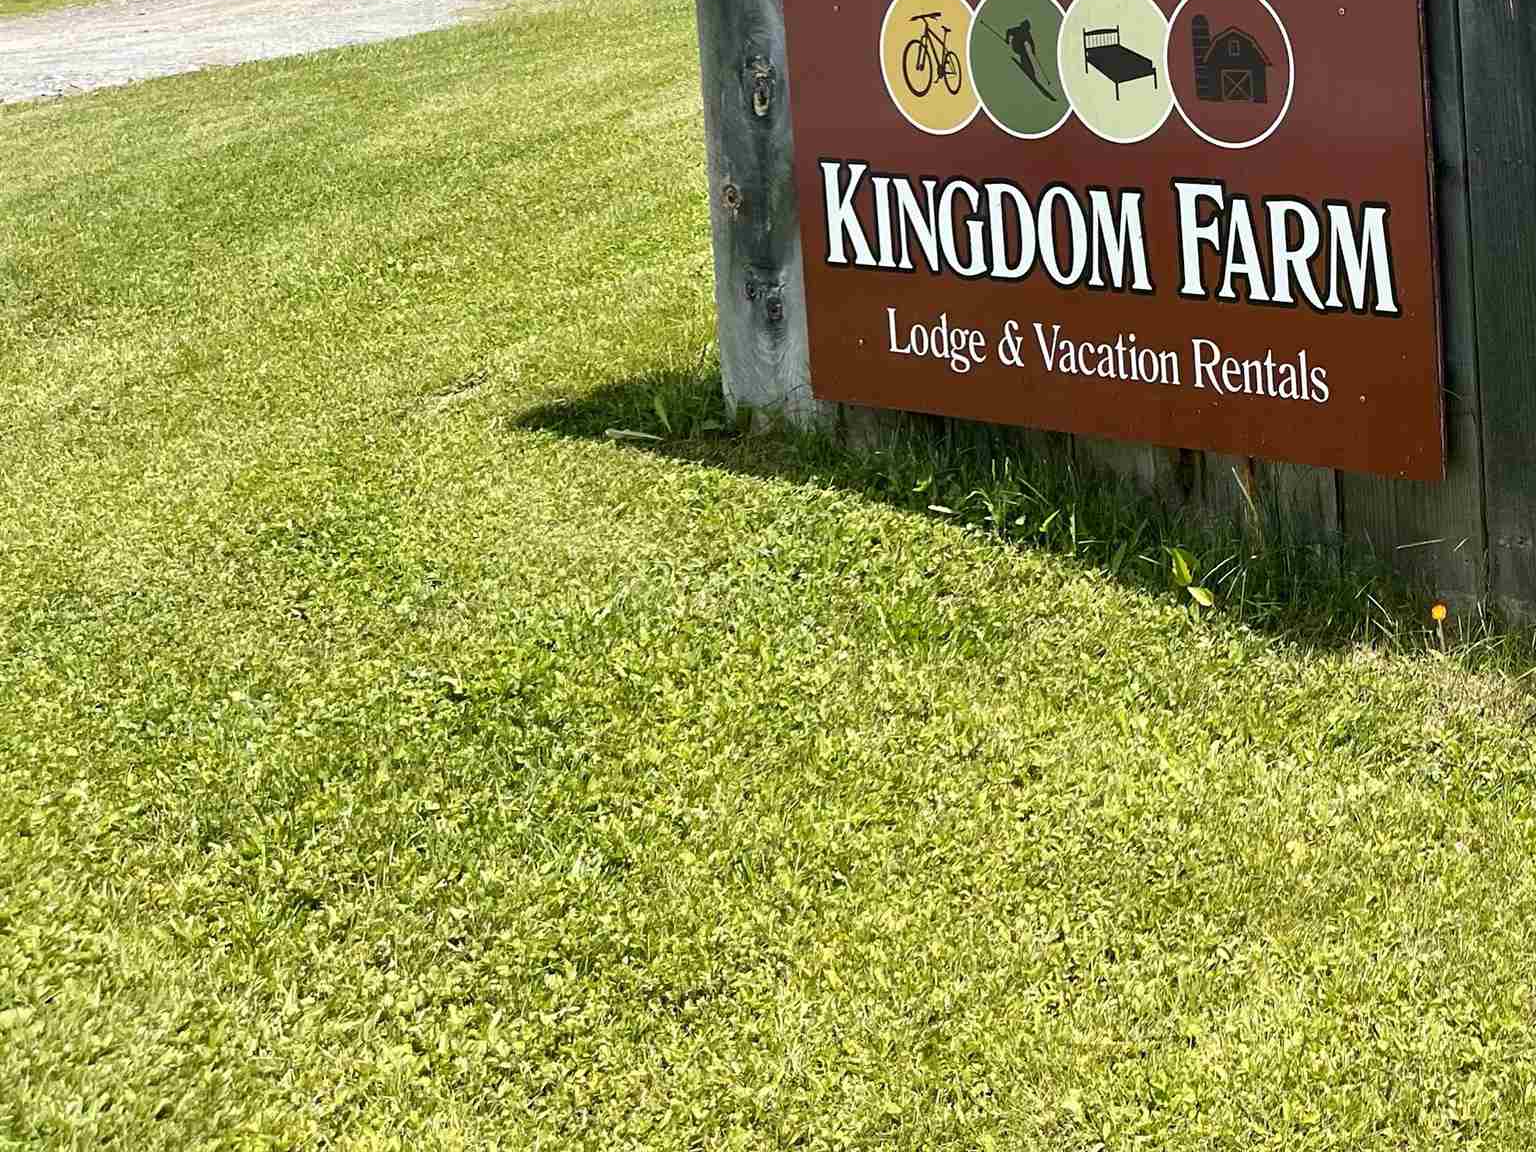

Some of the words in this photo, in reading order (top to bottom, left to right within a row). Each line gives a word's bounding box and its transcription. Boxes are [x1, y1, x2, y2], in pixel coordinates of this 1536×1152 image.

[818, 159, 1155, 294] KINGDOM
[1172, 179, 1401, 315] FARM
[886, 307, 986, 373] Lodge
[997, 319, 1024, 367] &
[1032, 322, 1180, 385] Vacation
[1192, 339, 1330, 402] Rentals
